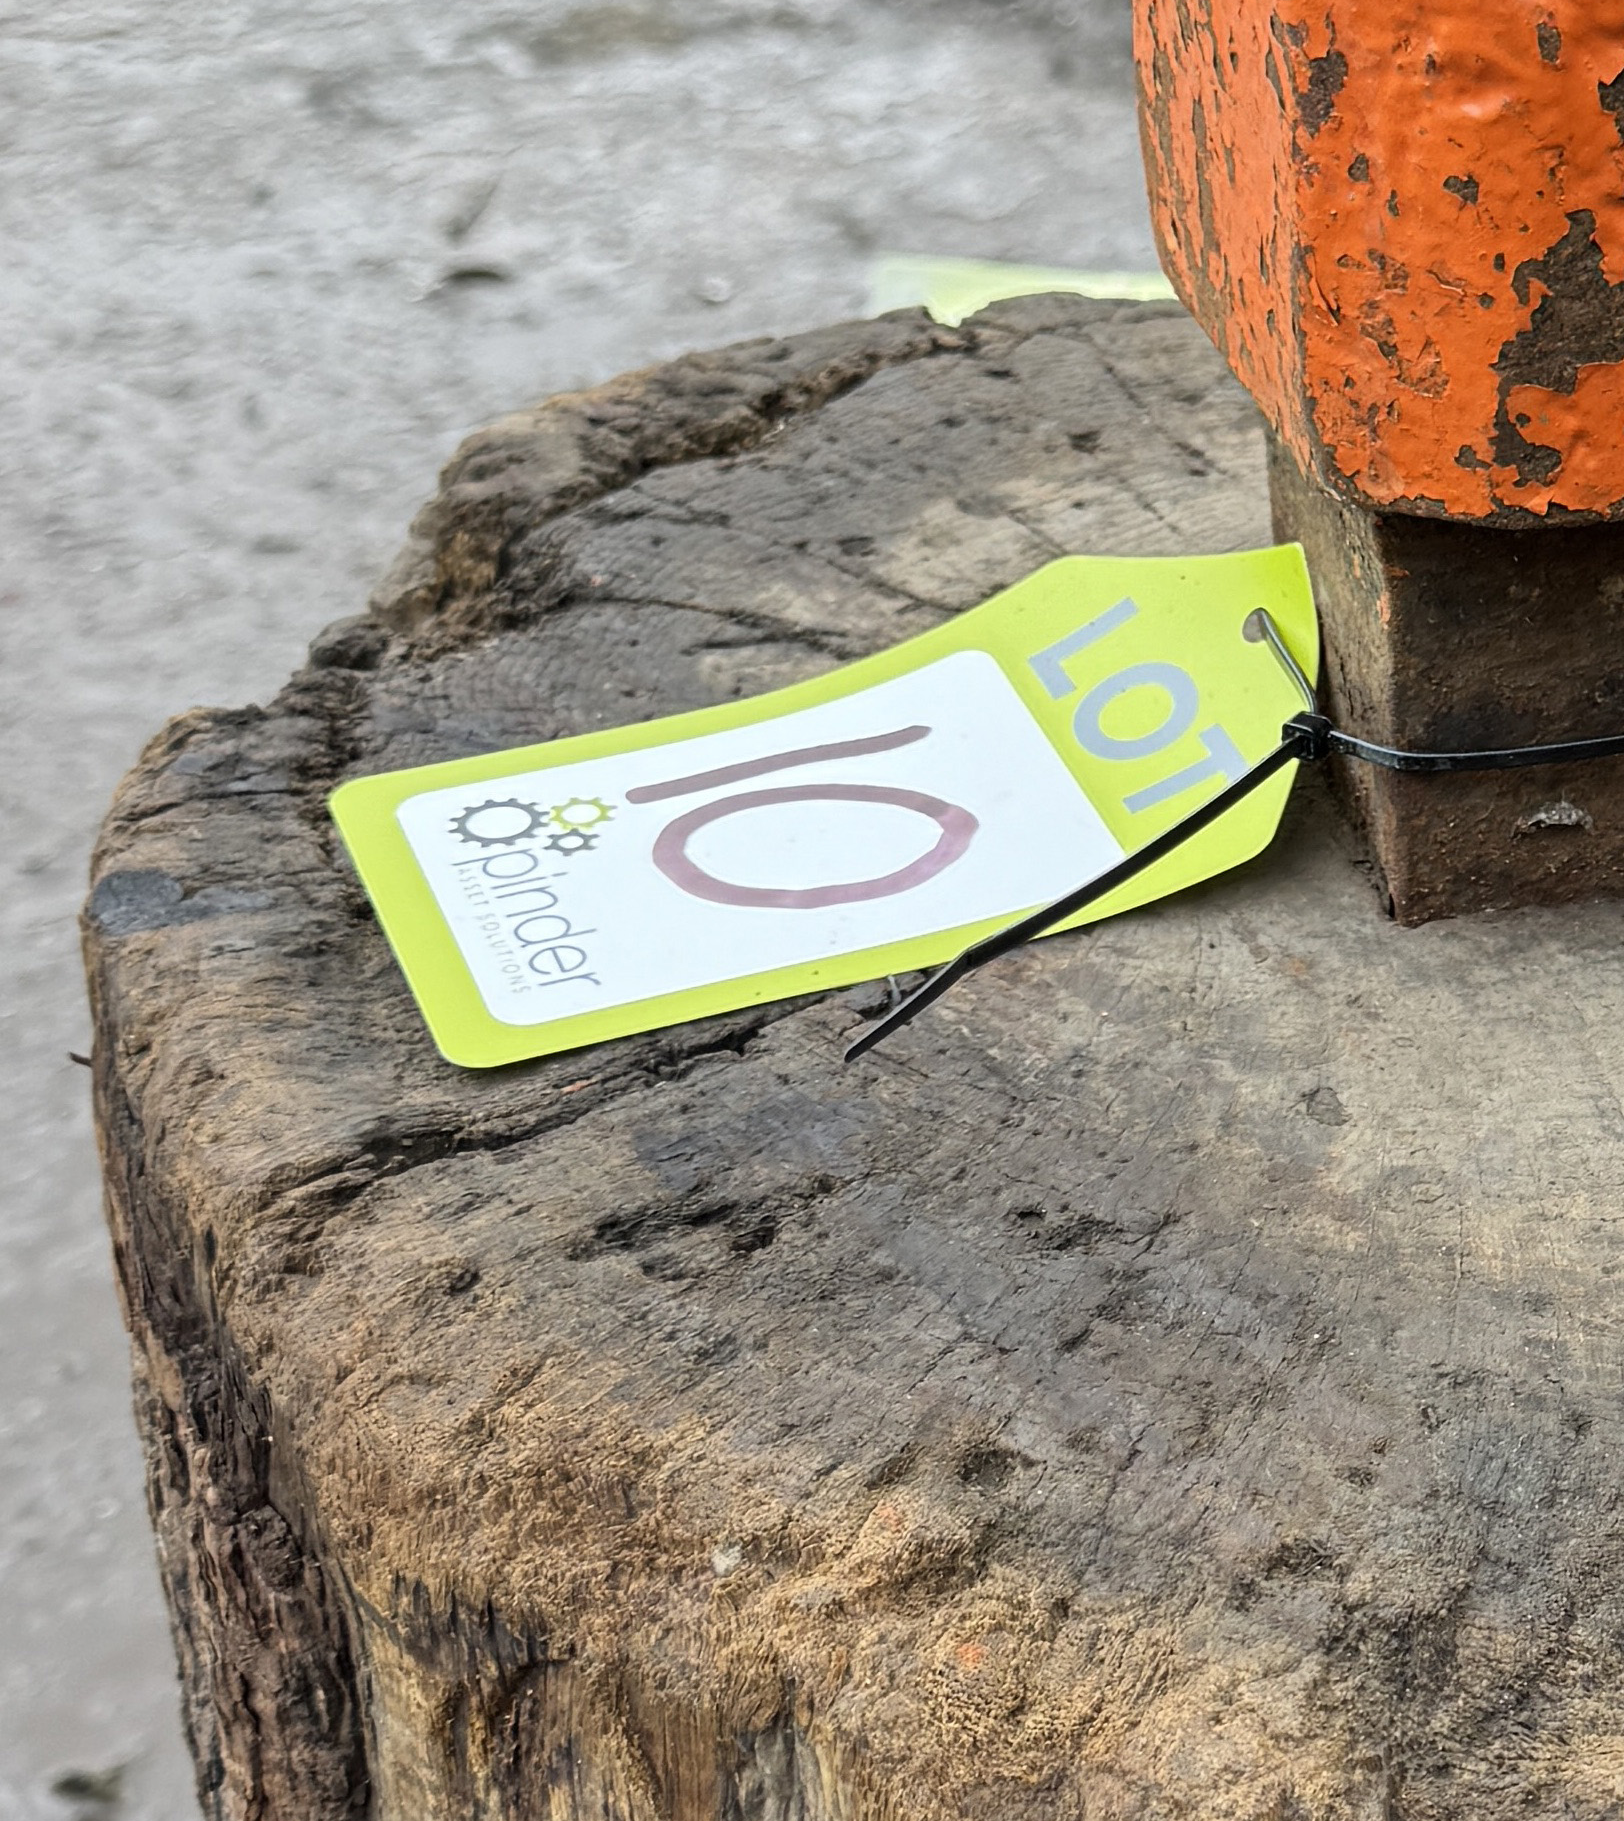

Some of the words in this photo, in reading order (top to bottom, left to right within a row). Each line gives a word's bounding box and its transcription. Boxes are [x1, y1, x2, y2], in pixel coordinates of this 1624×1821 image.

[1027, 596, 1250, 815] LOT
[625, 725, 980, 908] 10
[451, 848, 602, 987] pinder
[457, 869, 490, 907] ASSET
[474, 912, 532, 994] SOLUTIONS
